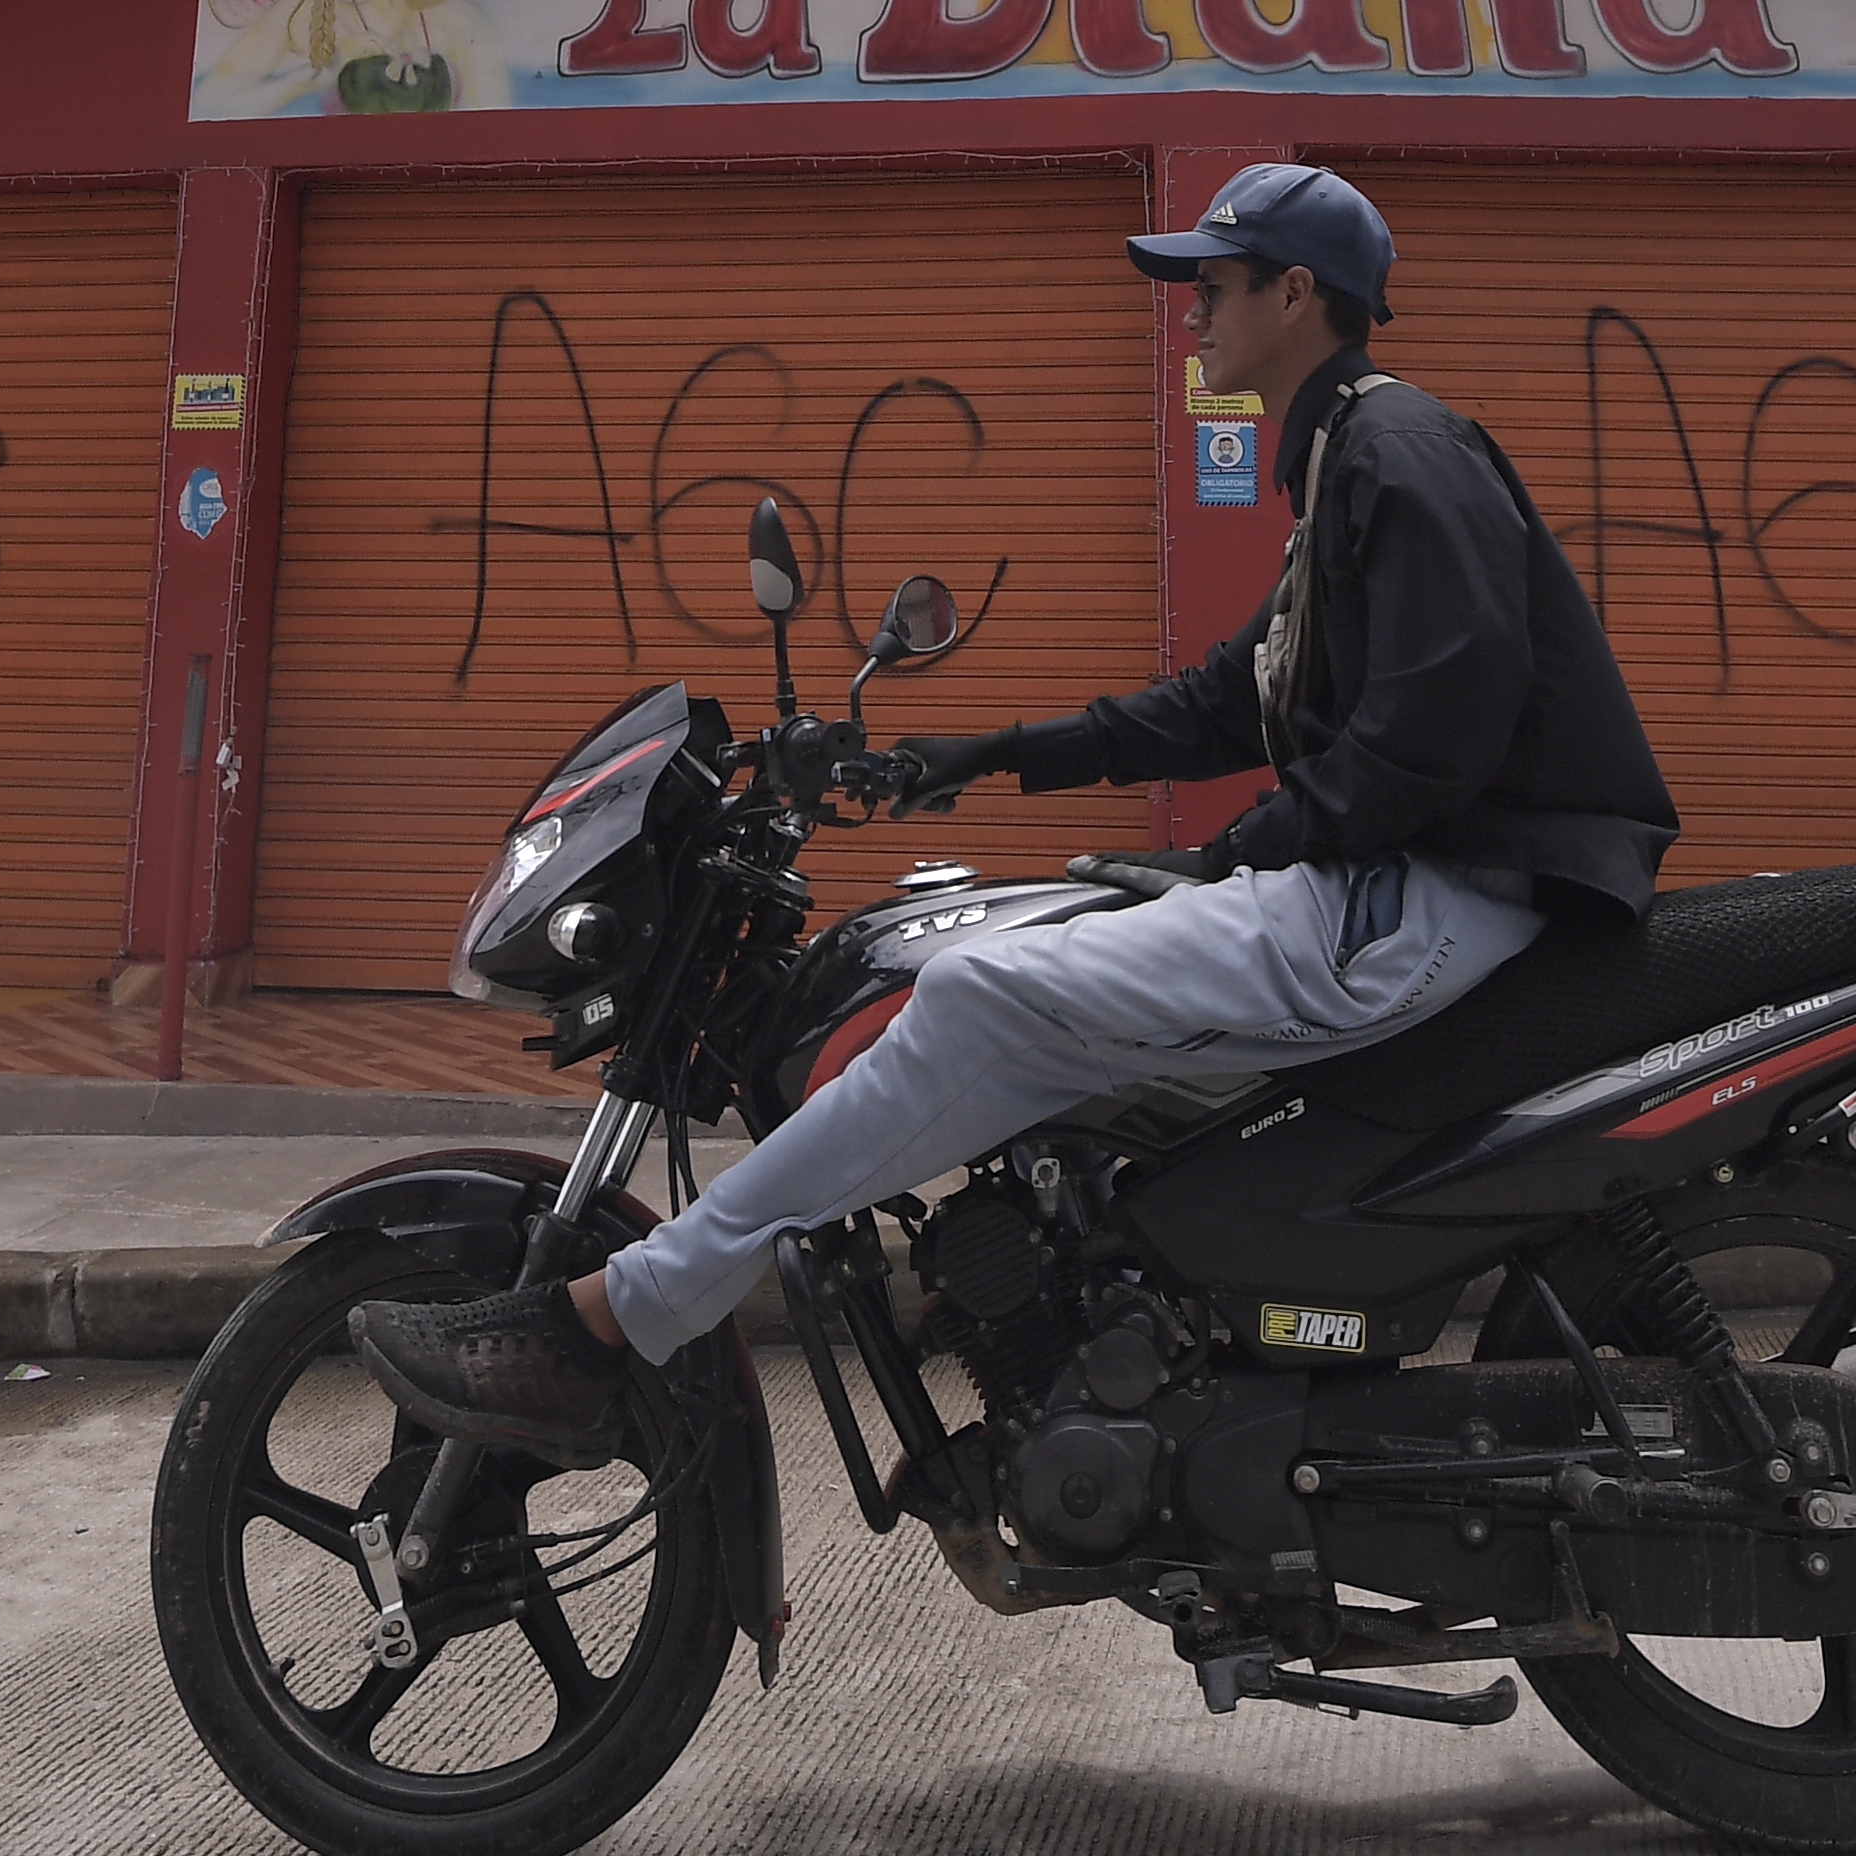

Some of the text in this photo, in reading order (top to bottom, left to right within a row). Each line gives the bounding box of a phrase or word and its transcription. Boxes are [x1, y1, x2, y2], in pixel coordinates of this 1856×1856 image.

[1200, 479, 1254, 487] OBLIGATORIO
[898, 901, 989, 942] TVS
[1423, 934, 1456, 987] KEEP
[1638, 994, 1831, 1080] Sport 100
[1711, 1075, 1758, 1106] ELS
[1296, 1311, 1362, 1349] TAPER
